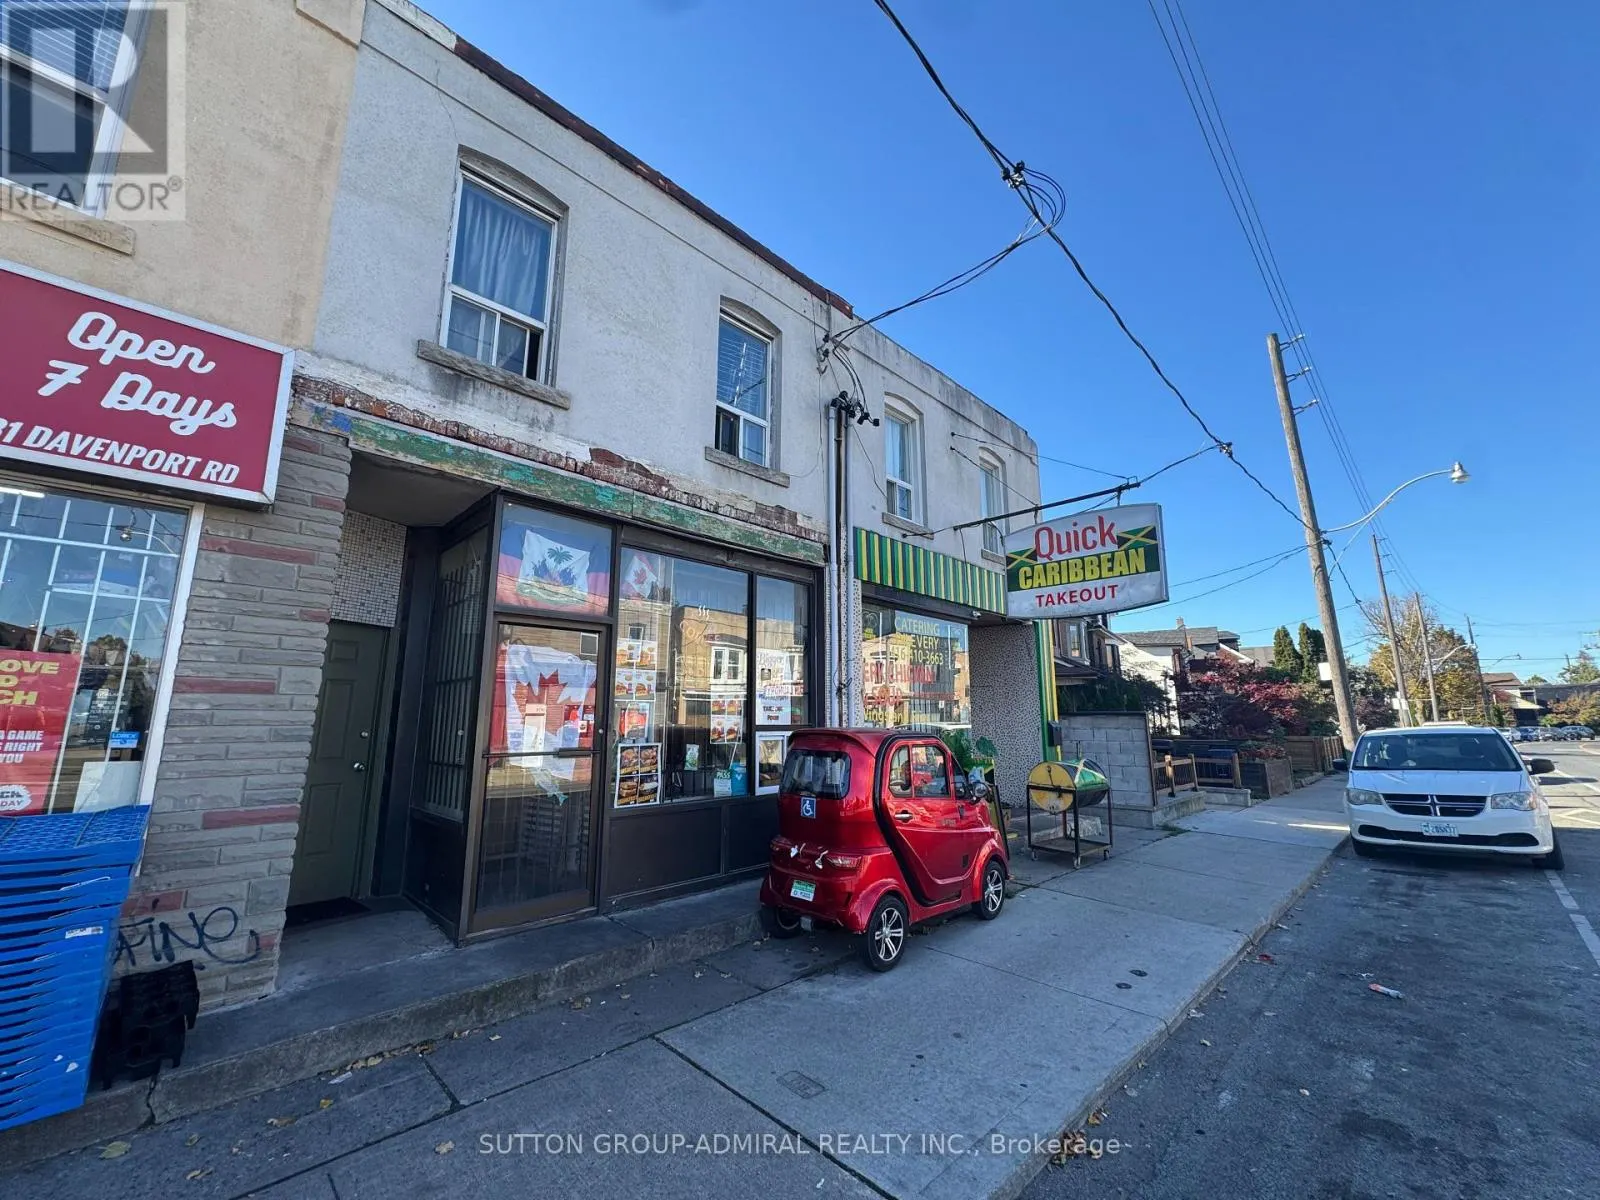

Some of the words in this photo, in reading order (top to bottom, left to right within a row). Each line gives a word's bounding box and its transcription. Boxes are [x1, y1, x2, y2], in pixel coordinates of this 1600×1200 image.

[67, 311, 216, 374] Open
[37, 359, 89, 397] 7
[100, 371, 237, 436] Days
[22, 425, 202, 477] DAVENPORT
[200, 460, 241, 485] RD
[1034, 515, 1118, 561] Quick
[1018, 547, 1146, 590] CARIBBEAN
[1035, 585, 1119, 608] TAKEOUT
[894, 616, 940, 636] CATERING
[4, 741, 44, 752] RIGHT
[7, 730, 44, 741] GAME
